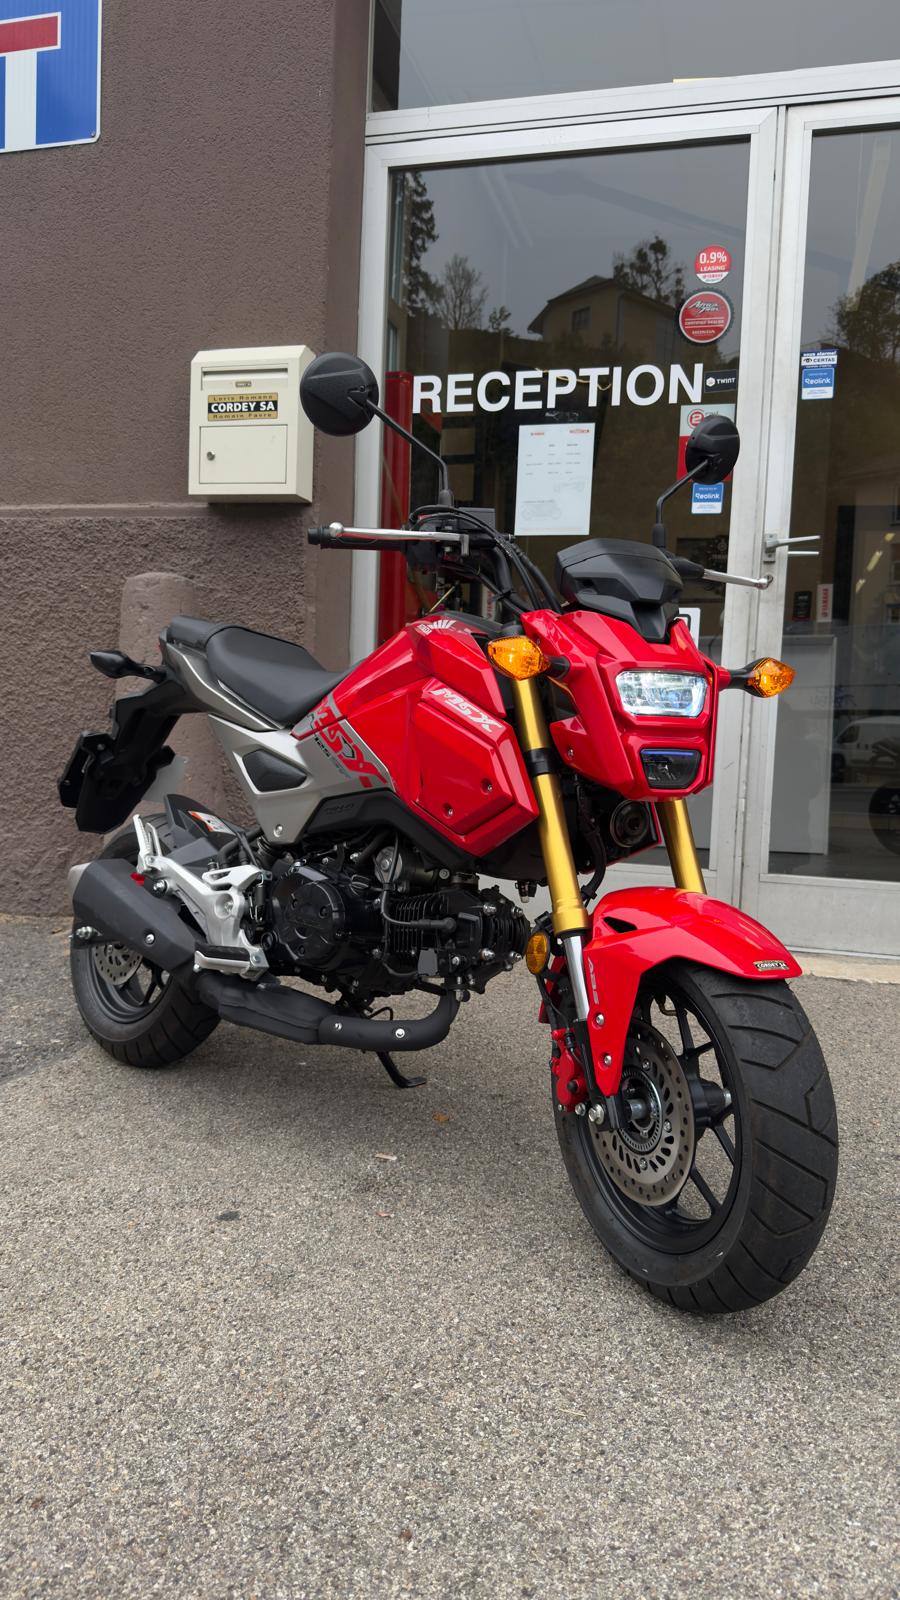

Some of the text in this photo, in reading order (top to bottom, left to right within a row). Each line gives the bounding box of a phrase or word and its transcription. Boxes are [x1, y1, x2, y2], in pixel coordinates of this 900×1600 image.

[699, 251, 727, 264] 0.9%
[716, 377, 736, 385] TWINT
[412, 363, 704, 414] RECEPTION
[211, 401, 275, 412] CORDEY SA
[695, 492, 720, 500] Reolink
[430, 687, 503, 732] MSX
